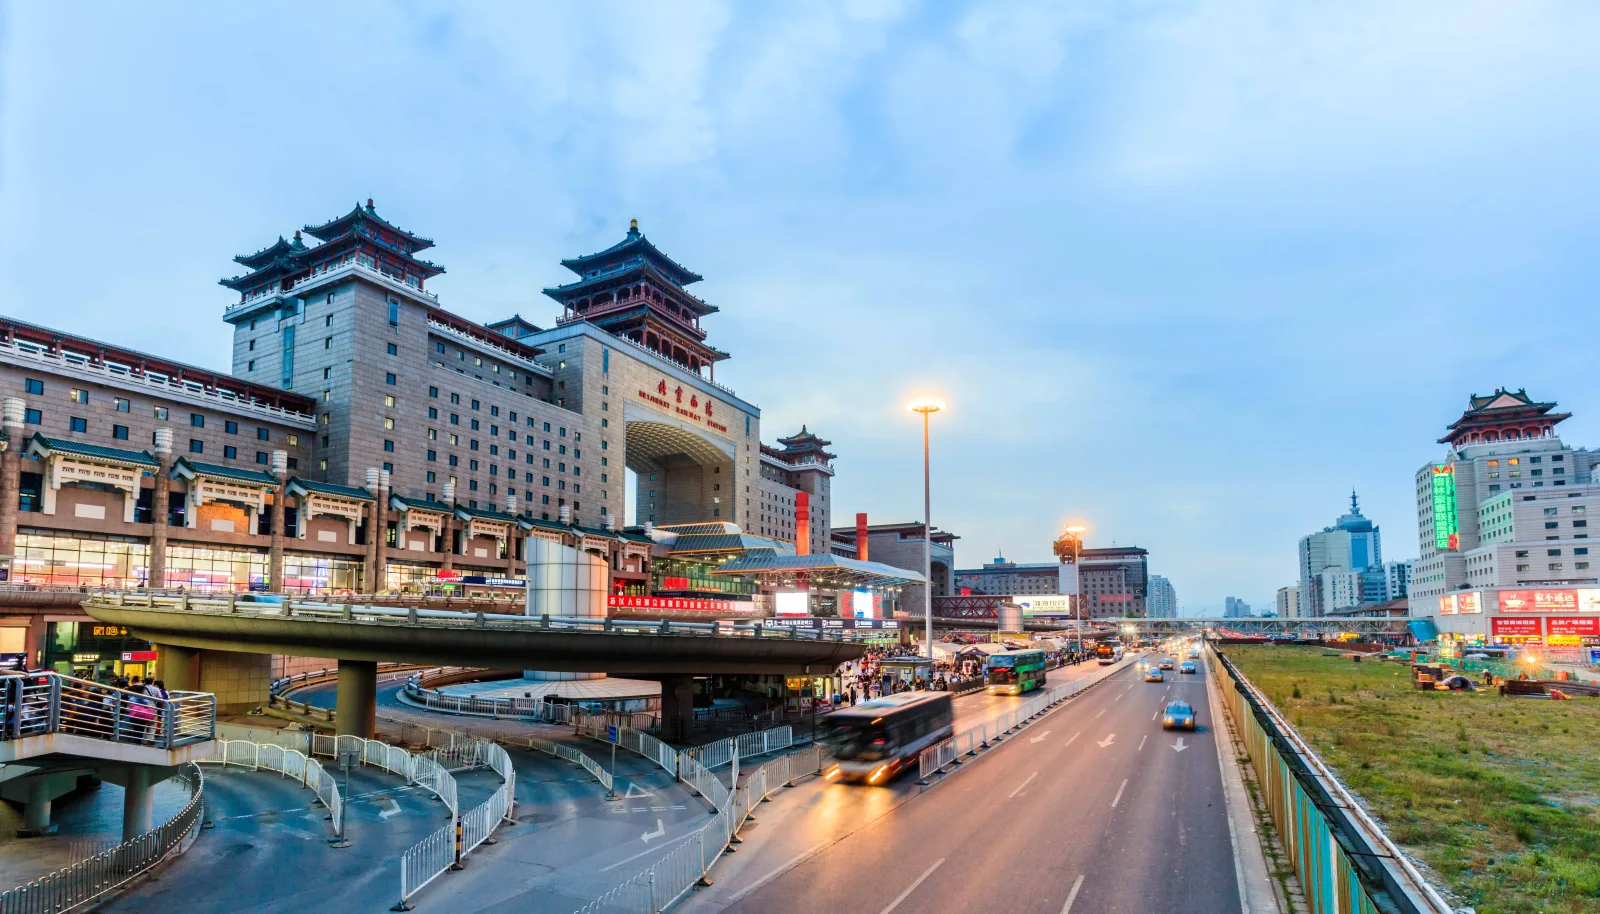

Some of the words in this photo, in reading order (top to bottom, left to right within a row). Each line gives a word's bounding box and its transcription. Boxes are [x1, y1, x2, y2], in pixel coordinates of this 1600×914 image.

[658, 379, 713, 417] 北京西站
[676, 406, 701, 421] RAILWAY
[707, 420, 727, 433] STATION
